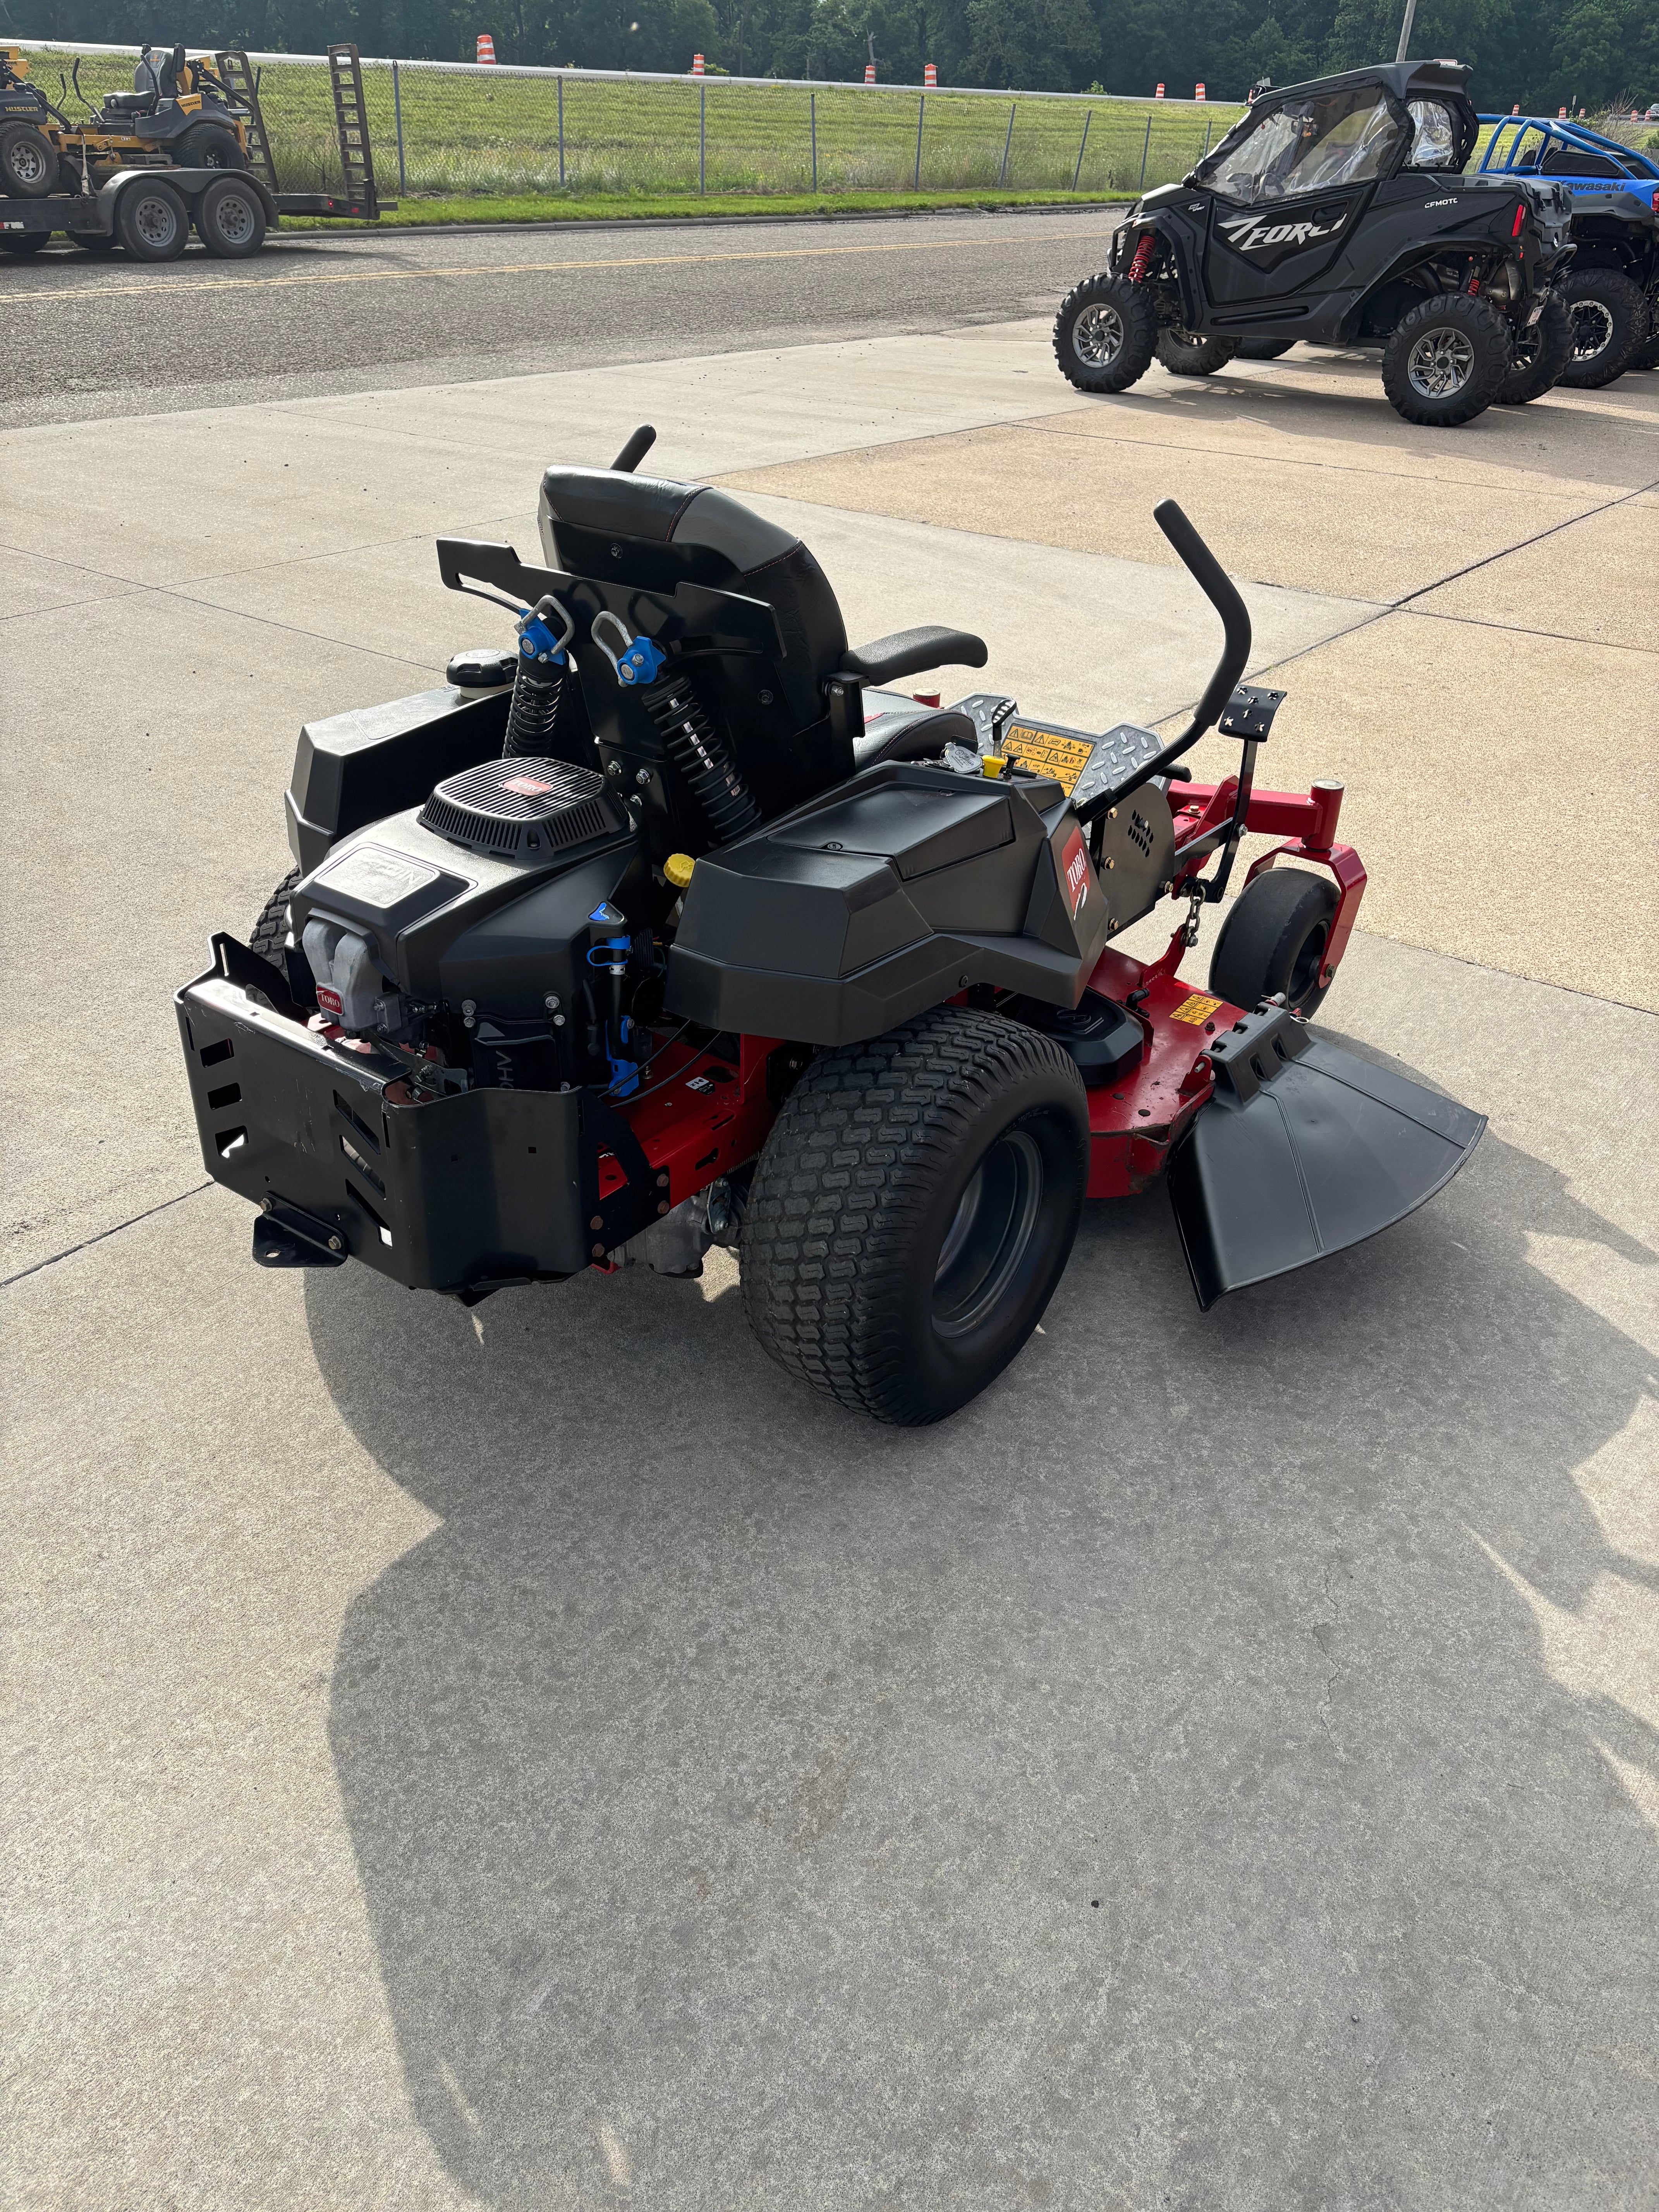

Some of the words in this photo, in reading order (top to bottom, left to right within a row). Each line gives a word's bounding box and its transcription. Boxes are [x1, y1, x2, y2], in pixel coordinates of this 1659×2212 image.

[1217, 213, 1347, 251] ZFOR
[511, 779, 543, 792] TORO
[1067, 848, 1085, 893] TORO
[320, 993, 340, 1007] TORO
